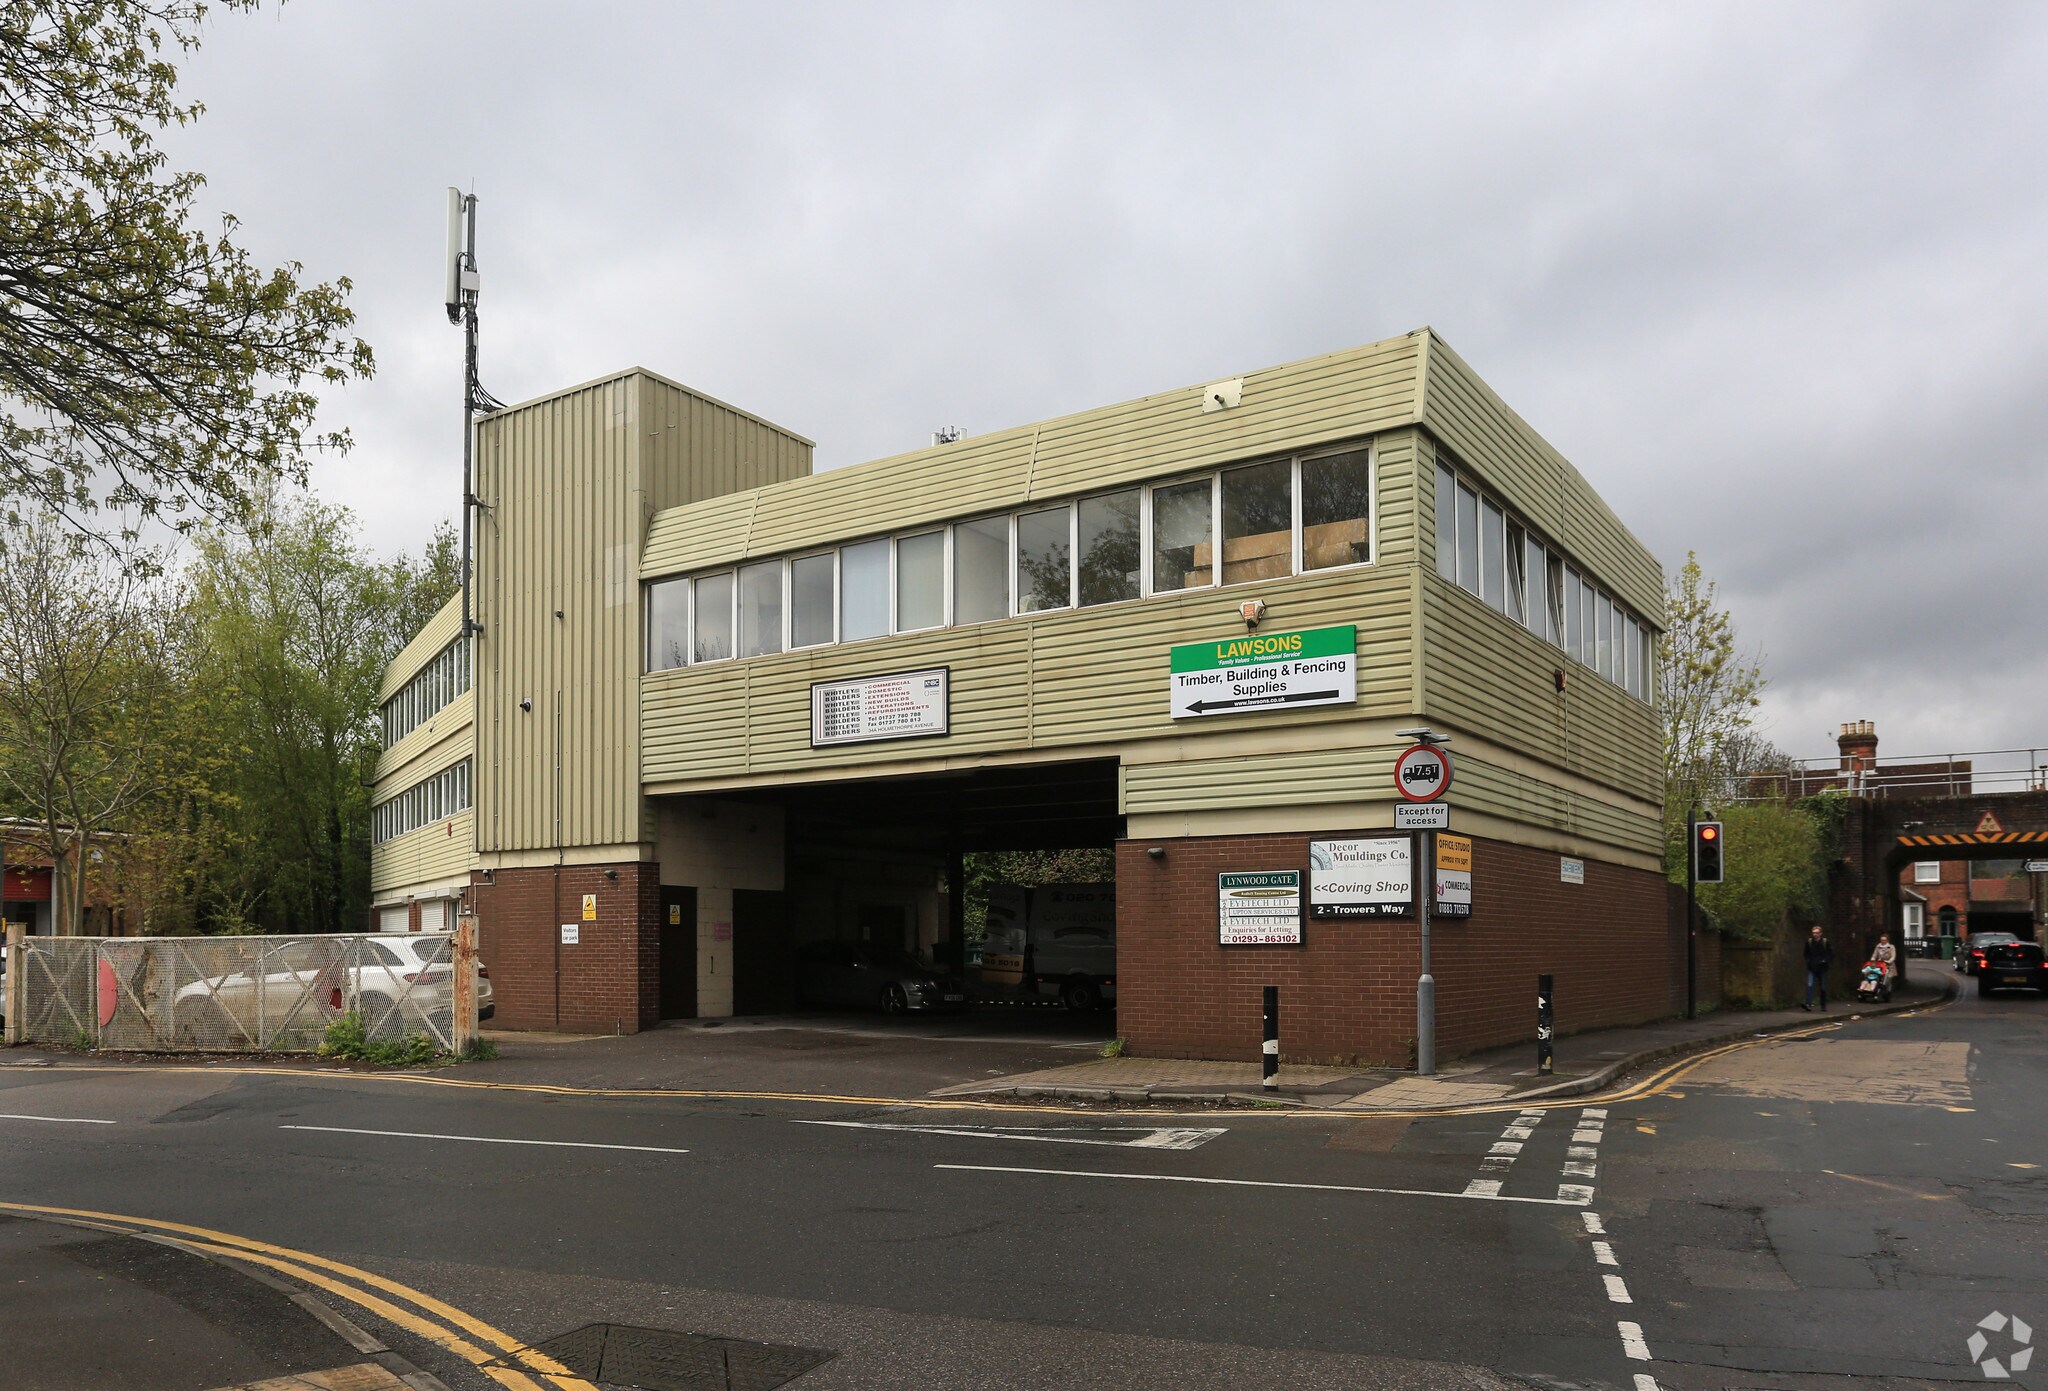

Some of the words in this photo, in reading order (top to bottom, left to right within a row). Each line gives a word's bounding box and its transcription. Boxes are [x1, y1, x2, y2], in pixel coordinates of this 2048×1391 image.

[1217, 635, 1302, 659] LAWSONS
[1254, 654, 1282, 662] Professional
[1178, 673, 1222, 686] Timber,
[1227, 667, 1277, 681] Building
[1281, 664, 1290, 676] &
[1294, 660, 1345, 674] Fencing
[868, 681, 911, 689] COMMERCIAL
[1233, 681, 1287, 696] Supplies
[825, 689, 854, 697] WHITLEY
[868, 691, 910, 699] EXTENSIONS
[825, 694, 860, 702] BUILDERS
[1234, 697, 1285, 706] www.lawsons.co.uk
[825, 705, 860, 713] BUILDERS
[868, 701, 914, 710] ALTERATIONS
[868, 705, 930, 715] REFURBISHMENTS
[825, 717, 860, 725] BUILDERS
[825, 723, 854, 731] WHITLEY
[825, 728, 860, 737] BUILDERS
[1398, 807, 1429, 816] Except
[1329, 842, 1358, 852] Decor
[1333, 851, 1387, 862] Mouldings
[1390, 849, 1408, 859] Co.
[1227, 876, 1268, 885] LYNWOOD
[1271, 875, 1292, 884] GATE
[1376, 881, 1408, 893] Shop
[1445, 880, 1471, 891] COMMERCIAL
[1230, 899, 1269, 907] EYETECH
[1317, 906, 1324, 914] 2
[1333, 906, 1376, 914] Trowers
[1381, 904, 1404, 914] Way
[1230, 917, 1269, 925] EYETECH
[1228, 926, 1257, 935] Enquiries
[1269, 926, 1292, 934] Letting
